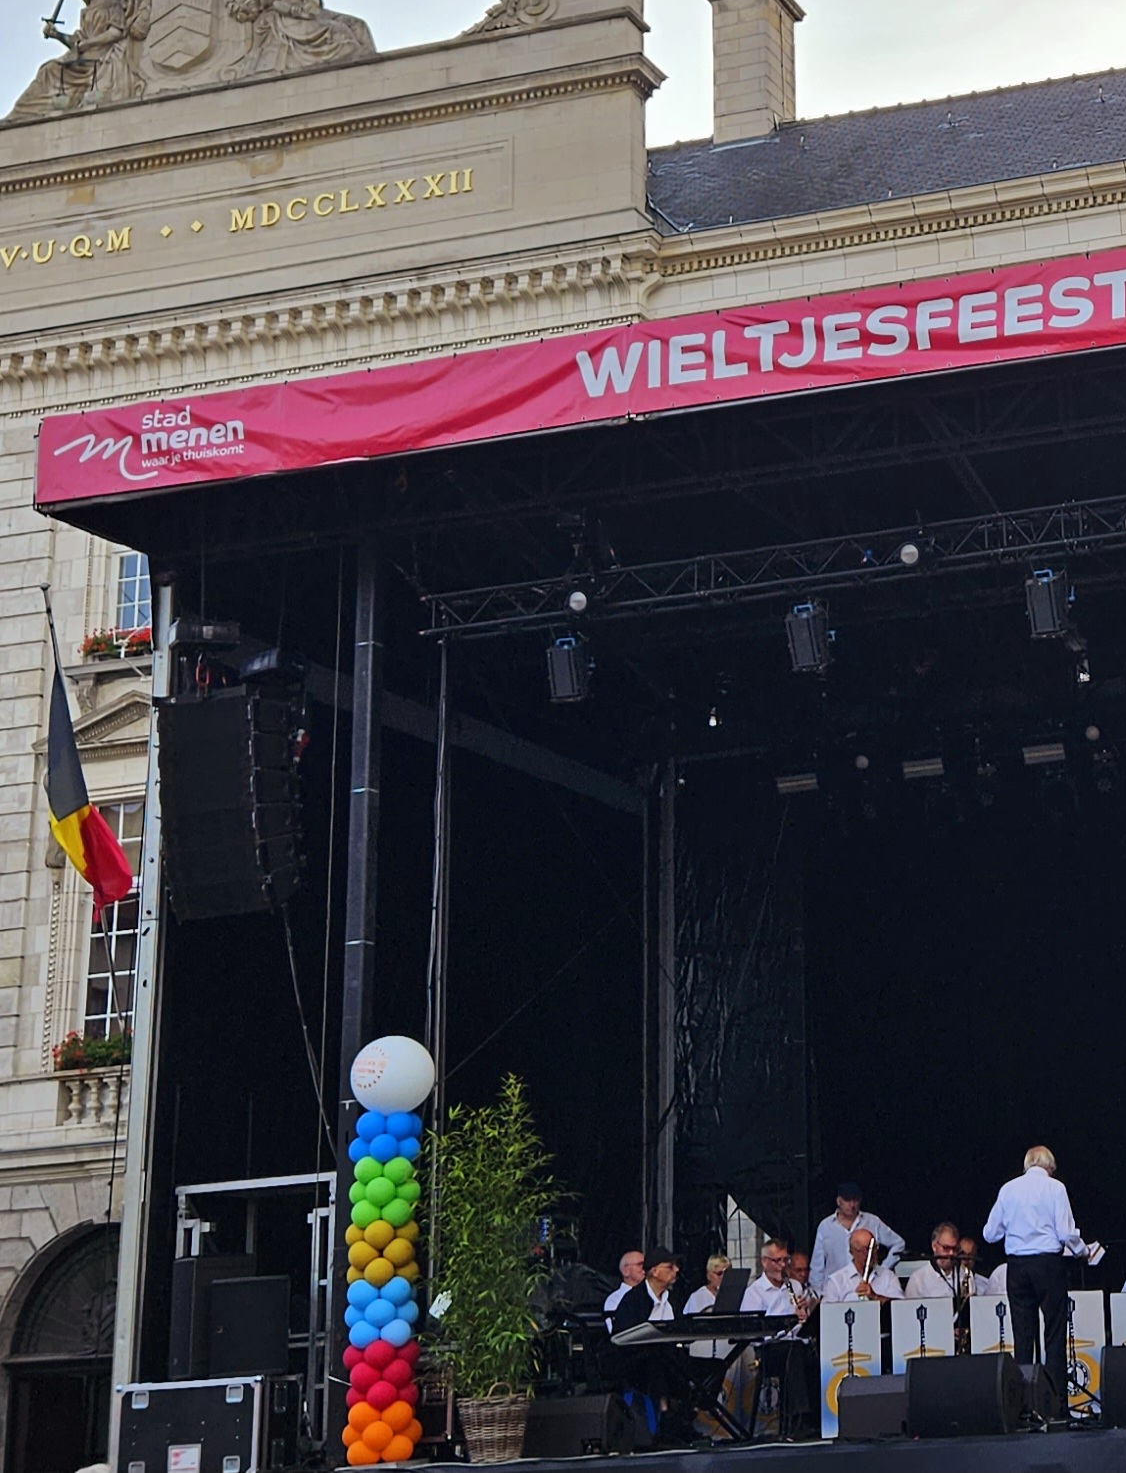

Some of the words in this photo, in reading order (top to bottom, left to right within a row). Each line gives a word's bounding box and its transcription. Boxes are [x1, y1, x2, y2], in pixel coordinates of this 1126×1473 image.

[229, 168, 473, 232] MDCCLXXXII
[142, 405, 191, 429] stad
[141, 420, 245, 454] menen
[141, 454, 170, 468] waar
[170, 452, 182, 466] je
[183, 444, 245, 462] thuiskomt
